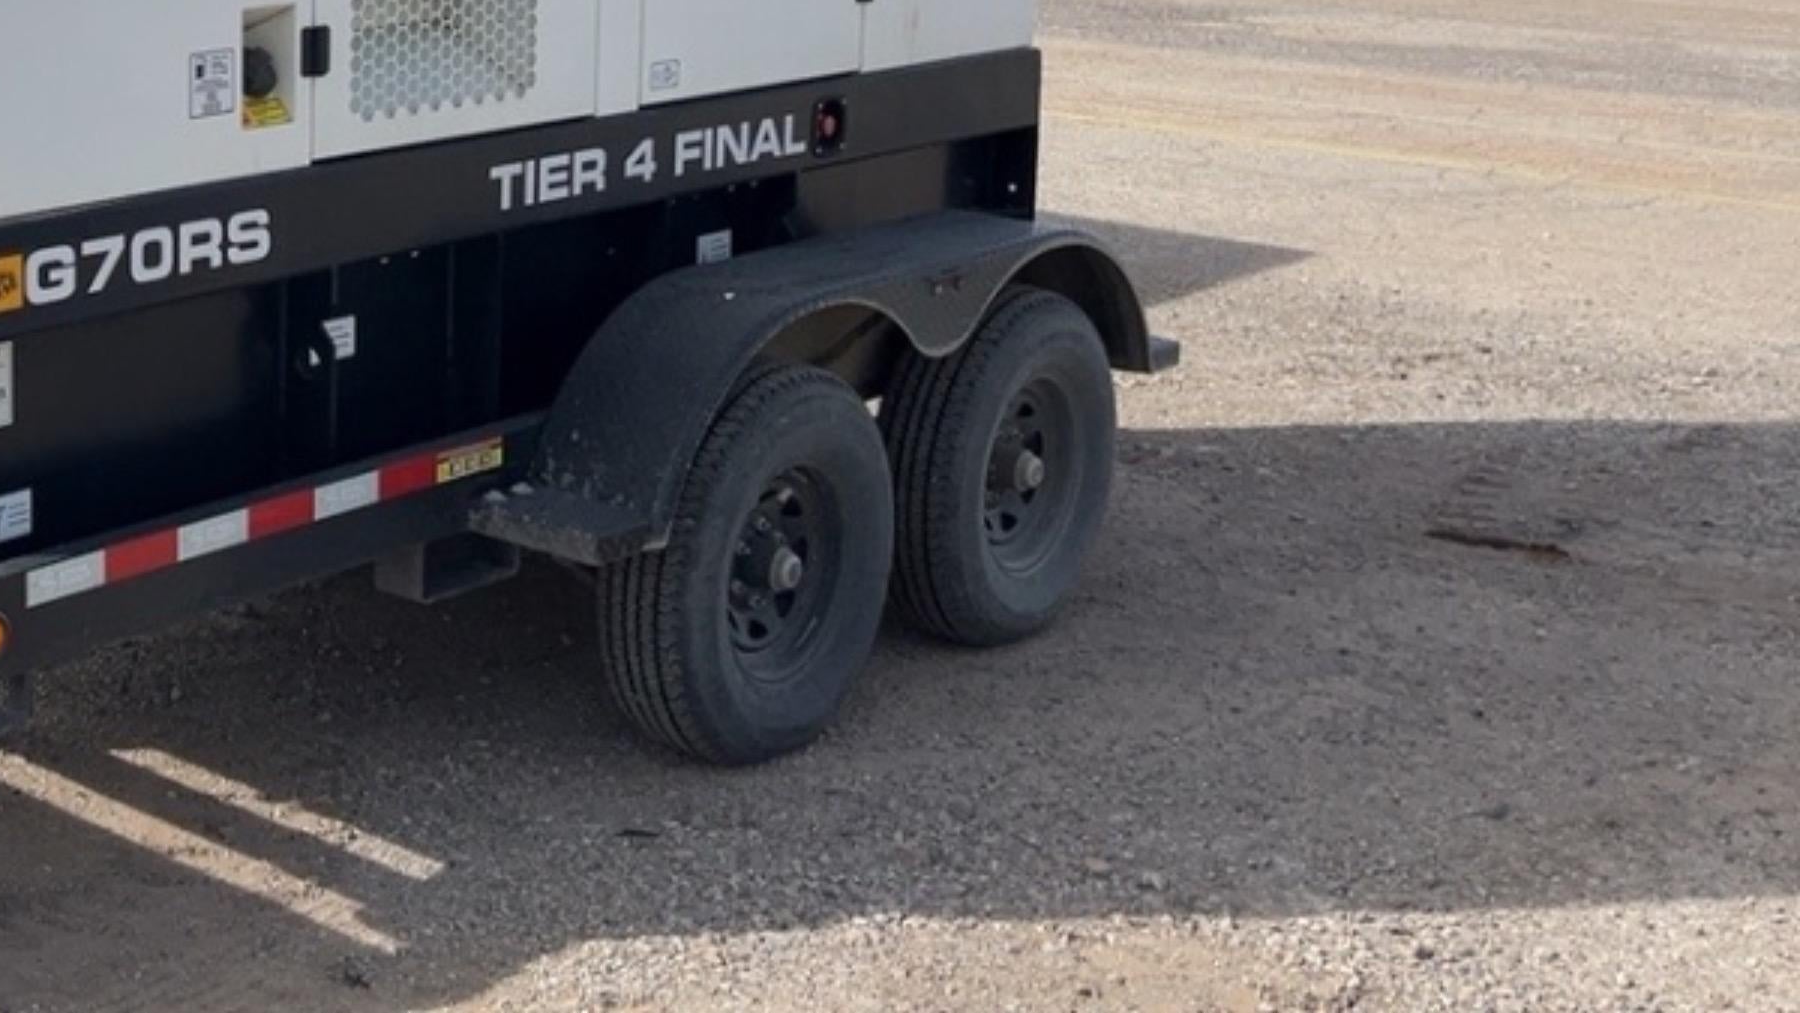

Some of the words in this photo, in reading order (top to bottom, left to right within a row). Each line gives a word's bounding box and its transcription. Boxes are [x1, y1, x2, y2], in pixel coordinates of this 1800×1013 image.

[488, 147, 608, 212] TIER
[622, 137, 658, 183] 4
[672, 113, 807, 177] FINAL
[26, 208, 272, 306] G70RS
